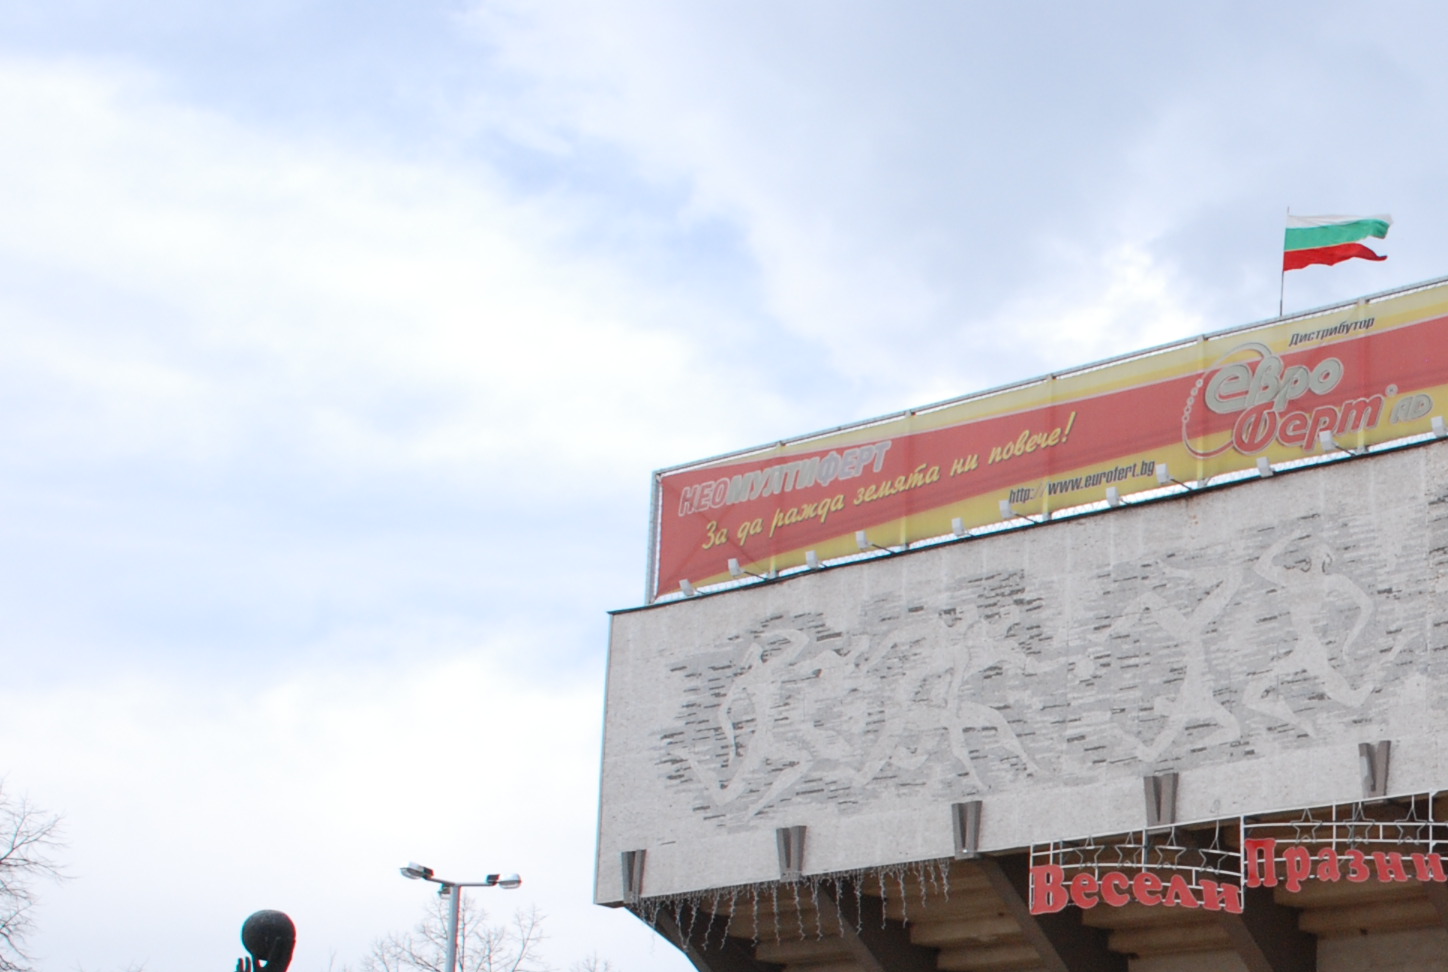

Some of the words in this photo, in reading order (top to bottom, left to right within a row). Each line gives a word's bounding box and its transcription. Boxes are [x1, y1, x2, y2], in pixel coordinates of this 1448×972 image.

[1288, 316, 1376, 347] Дистрибутор
[678, 440, 893, 518] НЕОМУЛТИФЕРТ
[702, 520, 729, 550] За
[737, 517, 764, 547] да
[769, 494, 845, 539] ражда
[853, 463, 941, 506] земята
[950, 453, 981, 477] ни
[988, 411, 1077, 465] повече!
[1029, 862, 1244, 915] Весели
